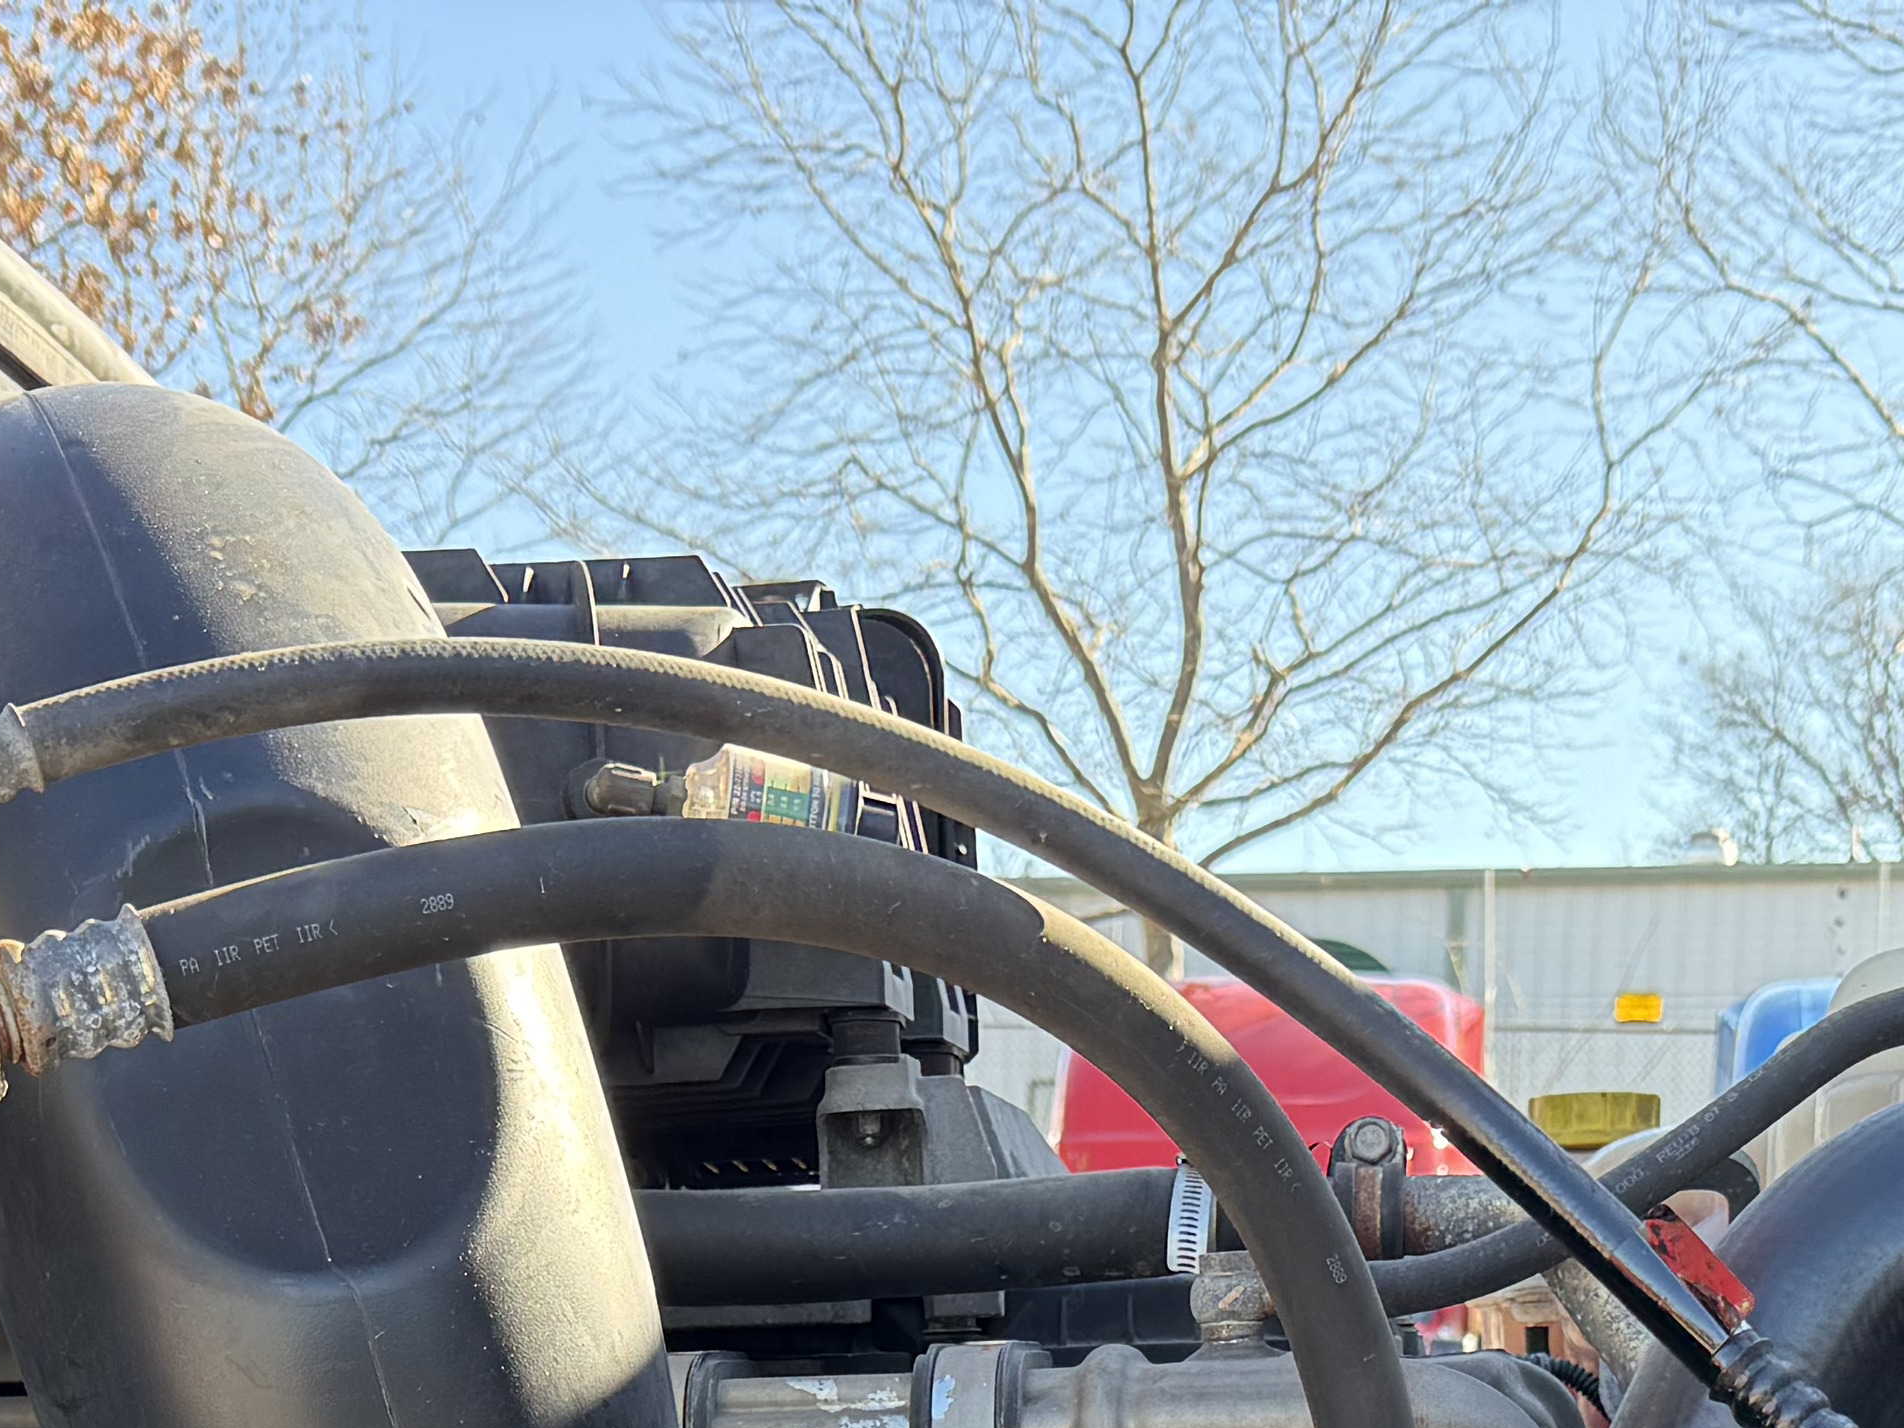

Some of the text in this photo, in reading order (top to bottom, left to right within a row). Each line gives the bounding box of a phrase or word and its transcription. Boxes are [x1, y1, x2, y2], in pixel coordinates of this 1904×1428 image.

[179, 956, 200, 975] PA
[253, 934, 282, 955] PET
[1250, 1125, 1276, 1152] PET
